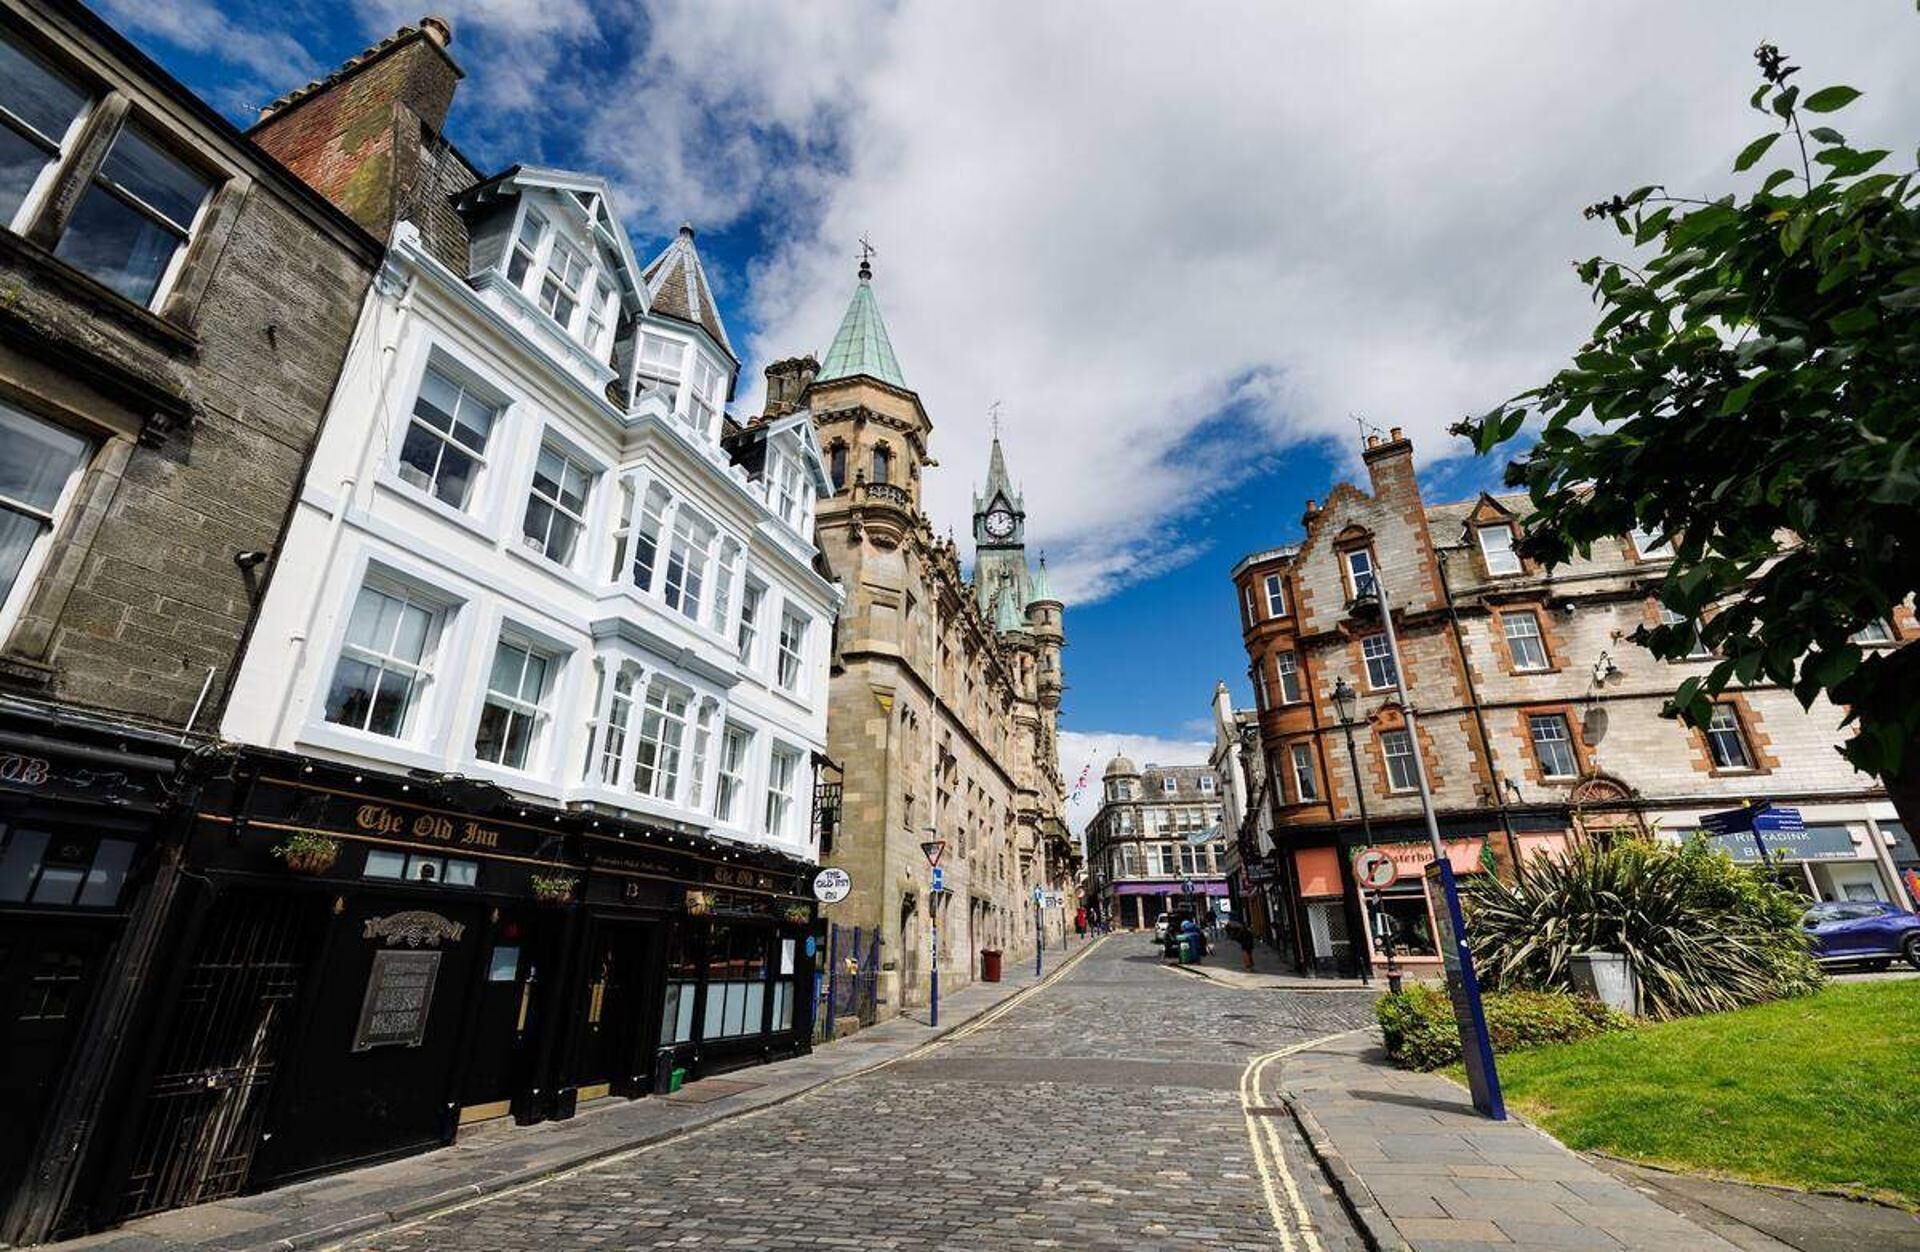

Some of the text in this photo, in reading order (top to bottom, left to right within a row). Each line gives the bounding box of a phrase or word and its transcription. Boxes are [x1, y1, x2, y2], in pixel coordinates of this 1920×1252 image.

[356, 804, 499, 847] The Old Inn
[1735, 831, 1811, 843] RIKADINK
[825, 871, 841, 879] THE
[815, 879, 834, 888] OLD
